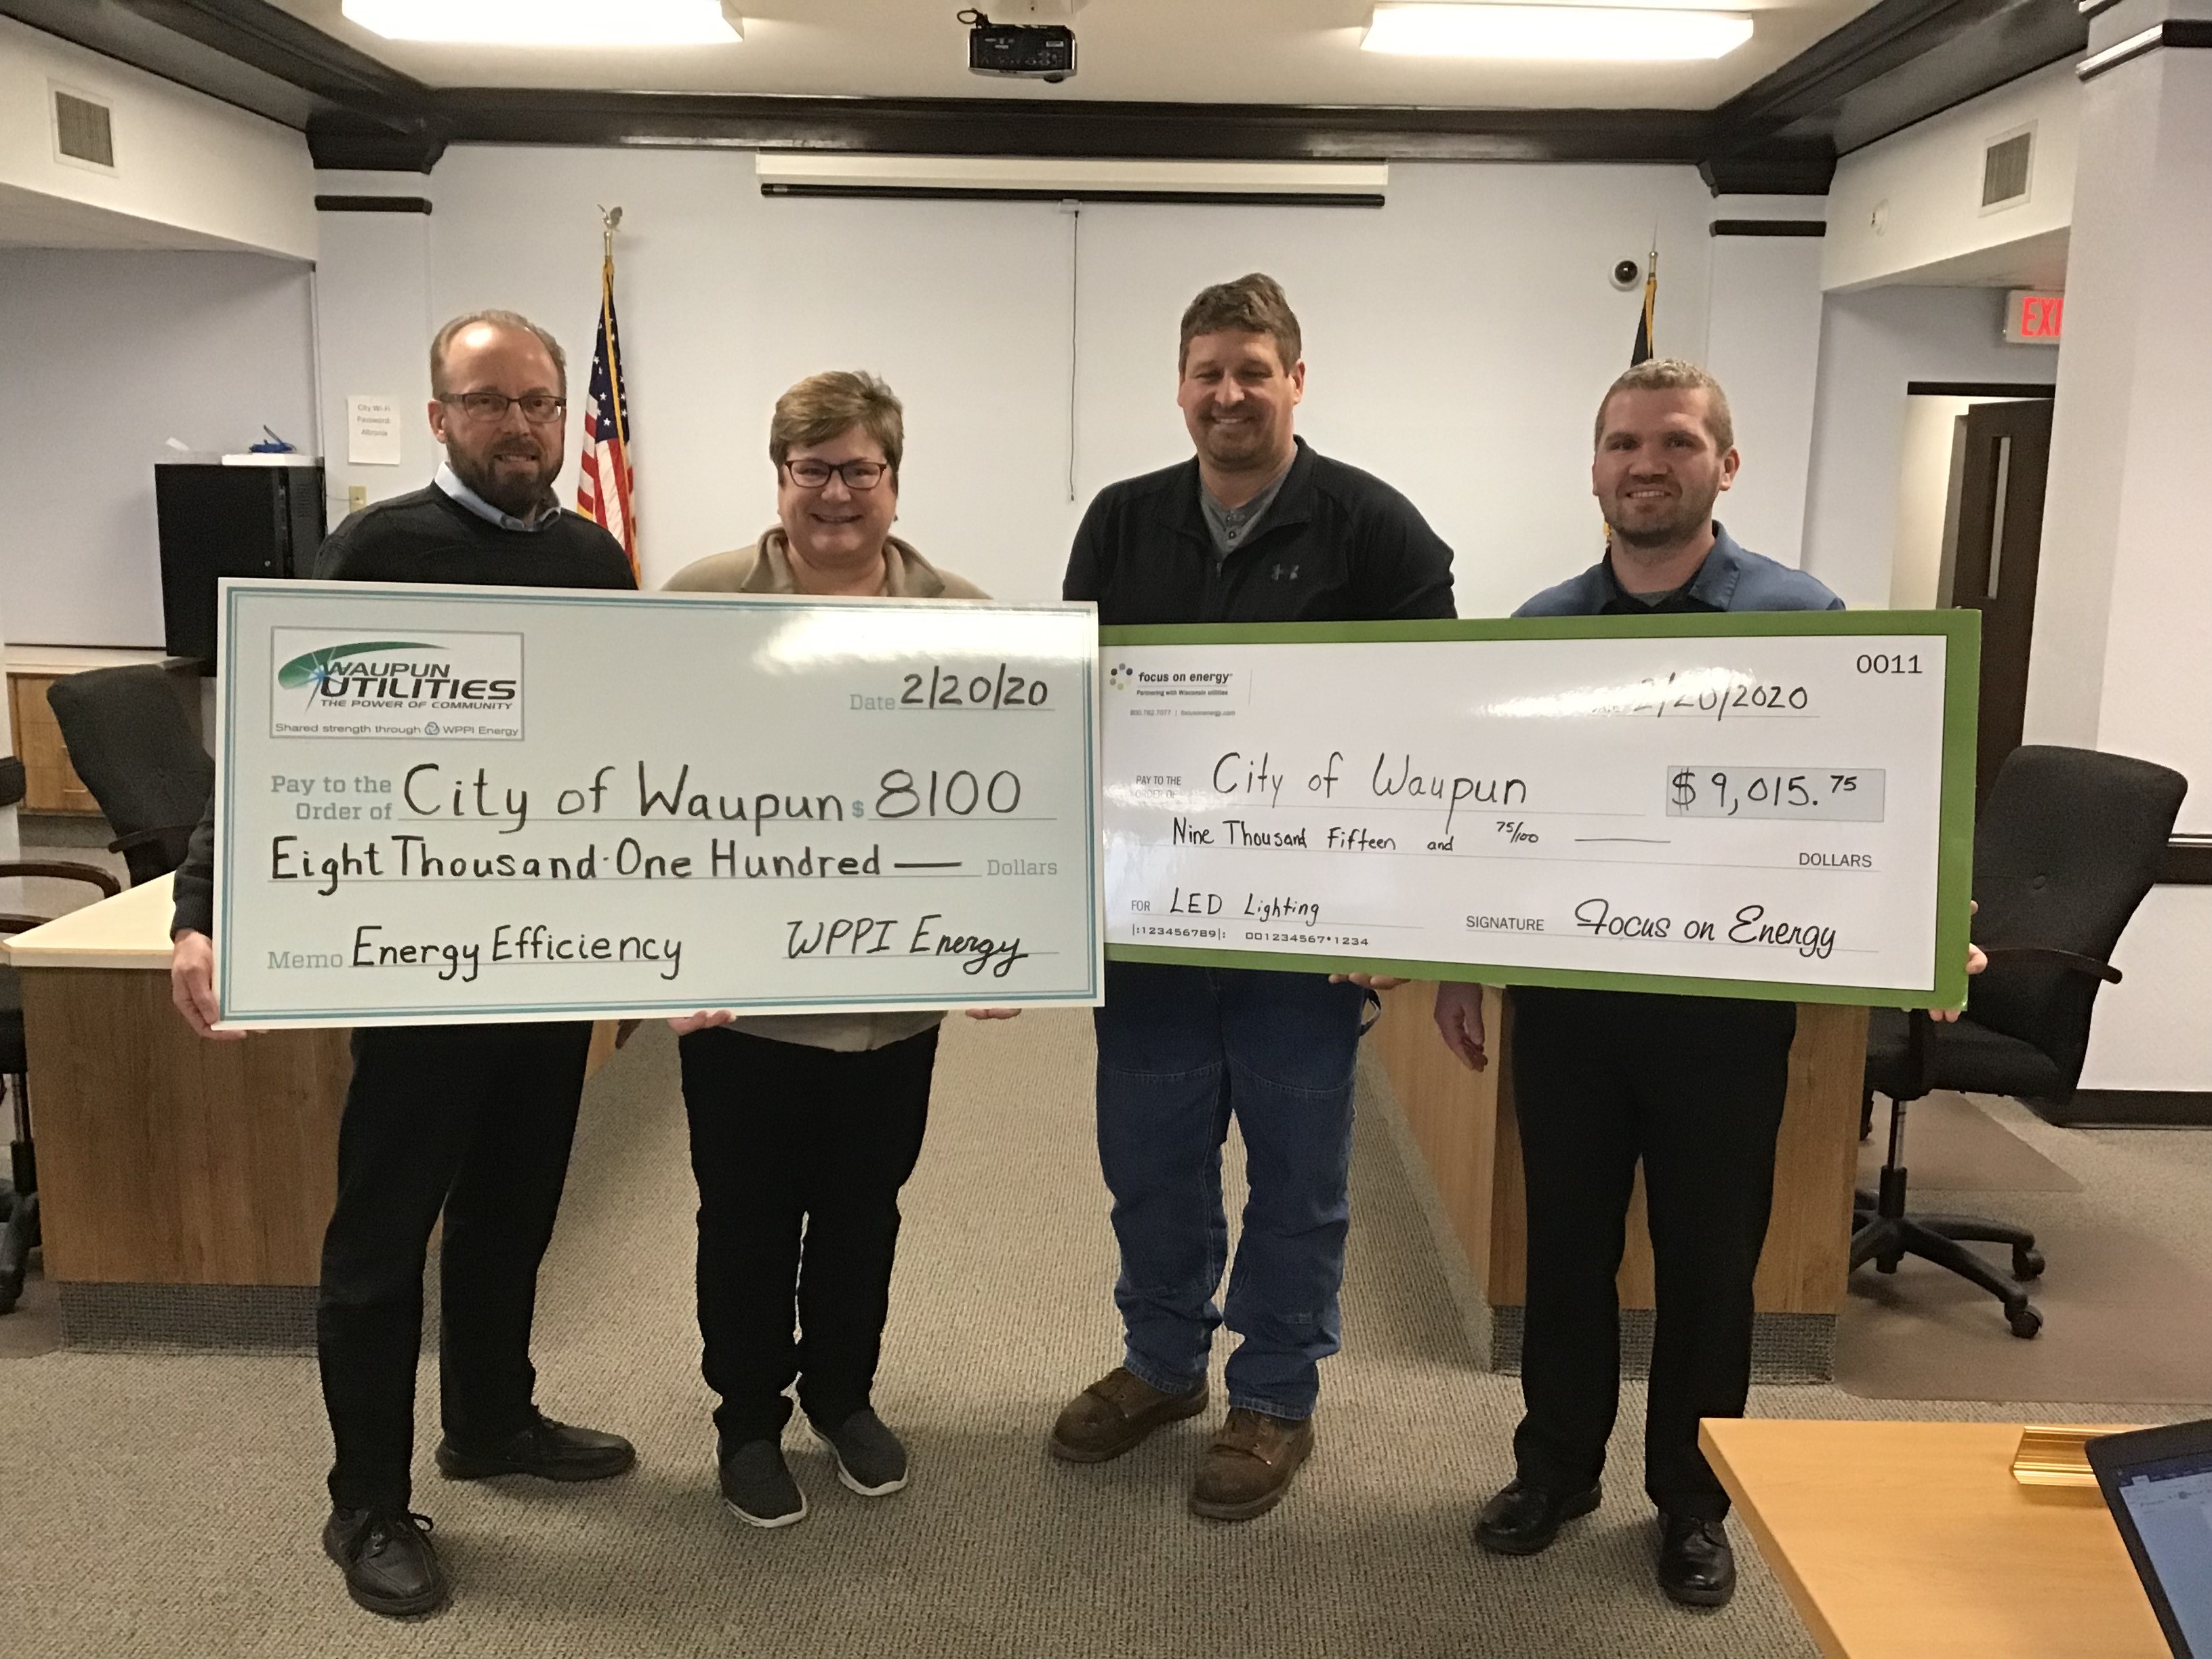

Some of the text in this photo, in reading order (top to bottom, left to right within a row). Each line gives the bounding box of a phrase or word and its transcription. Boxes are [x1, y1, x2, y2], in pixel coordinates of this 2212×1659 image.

[2021, 296, 2064, 337] EXI
[323, 661, 451, 678] WAUPUN
[1856, 654, 1923, 674] 0011
[901, 663, 1048, 710] 2/20/20
[1139, 672, 1229, 684] focus on energy
[321, 677, 516, 700] UTILITIES
[321, 699, 513, 710] THE POWER OF COMMUNITY
[850, 694, 895, 711] Date
[275, 722, 318, 733] Shared
[323, 723, 371, 735] strength
[375, 724, 421, 735] through
[478, 726, 518, 737] Energy
[271, 775, 392, 796] Pay to the
[1136, 775, 1182, 785] PAY TO THE
[404, 760, 843, 837] City of Waupun
[875, 769, 1021, 818] 8100
[1135, 790, 1163, 798] ORDER
[1213, 751, 1527, 834] City of Waupun
[296, 802, 392, 819] Order of
[852, 800, 864, 818] $
[1173, 816, 1539, 853] Nine Thousand Fifteen and 75/100
[272, 835, 384, 896] Eight
[712, 838, 881, 879] Hundred
[987, 859, 1058, 877] Dollars
[1799, 852, 1872, 867] DOLLARS
[1131, 899, 1151, 912] FOR
[1170, 887, 1320, 926] LED Lighting
[1466, 916, 1545, 932] SIGNATURE
[1574, 898, 1836, 959] Focus on Energy
[352, 924, 682, 982] Energy Efficiency
[786, 914, 1029, 978] WPPI Energy
[267, 951, 343, 969] Memo
